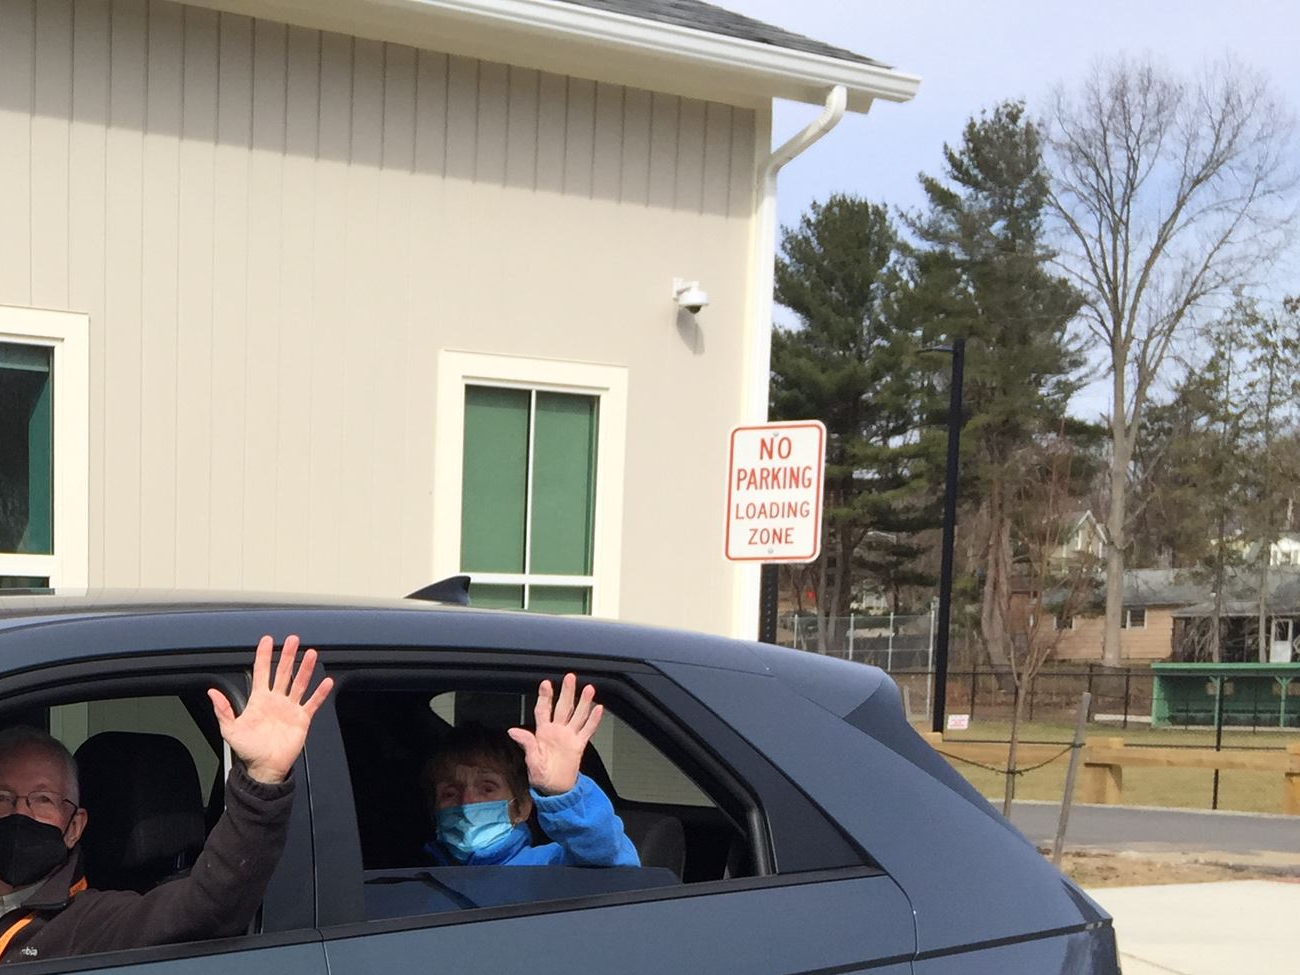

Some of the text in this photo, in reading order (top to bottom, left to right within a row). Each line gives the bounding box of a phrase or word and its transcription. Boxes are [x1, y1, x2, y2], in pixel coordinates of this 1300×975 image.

[760, 436, 792, 461] NO
[736, 466, 812, 491] PARKING
[735, 501, 810, 520] LOADING
[747, 527, 794, 545] ZONE
